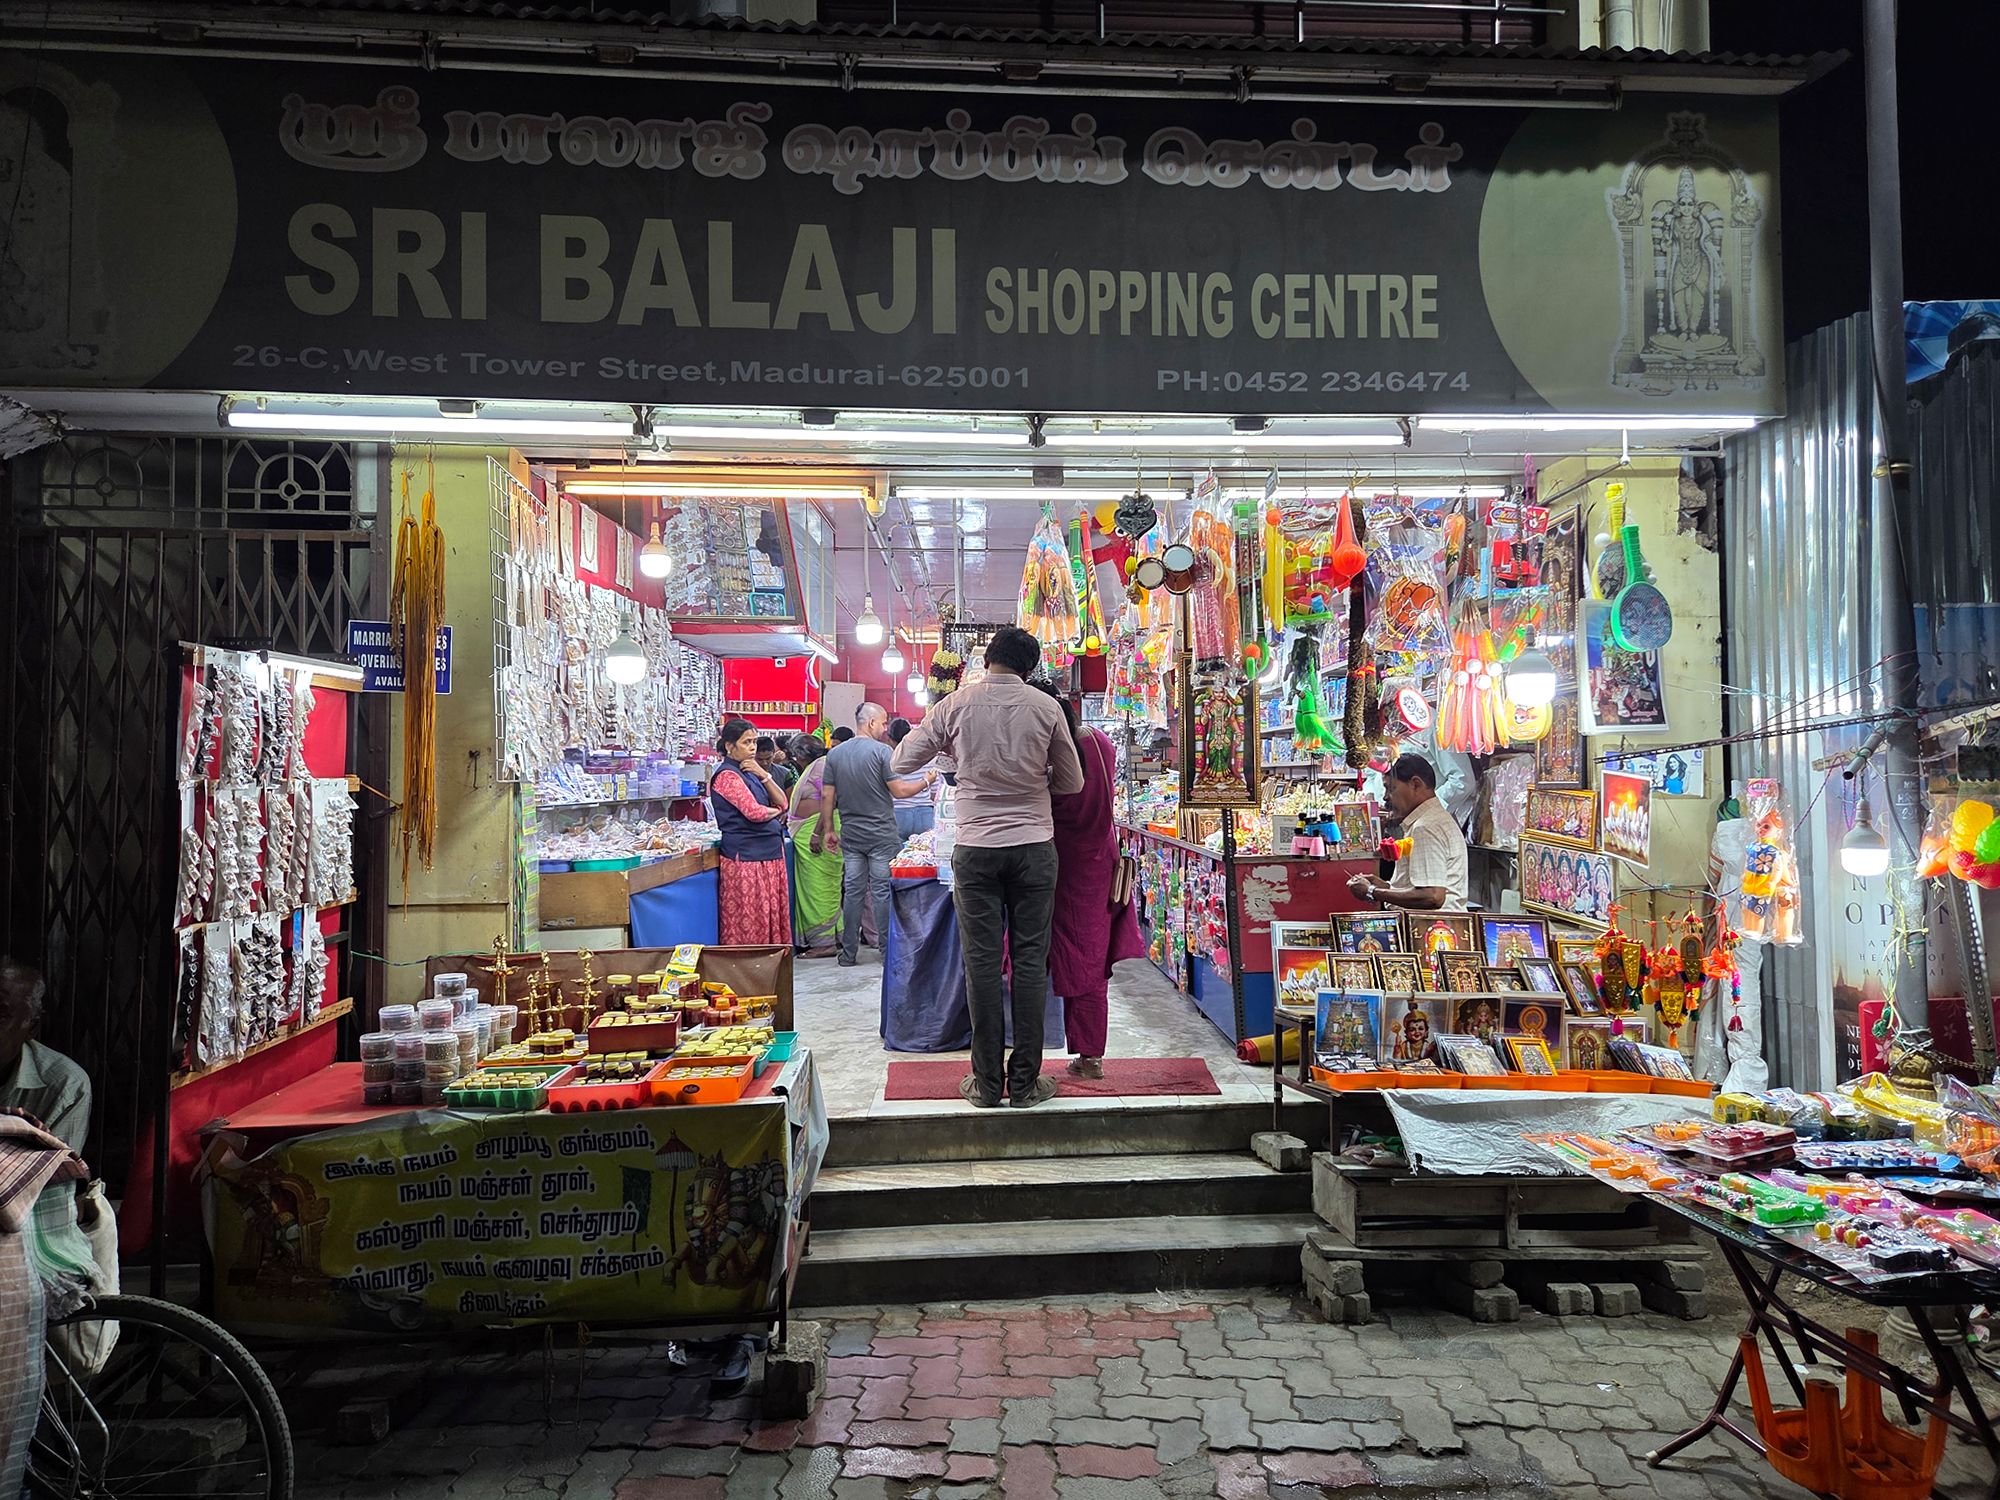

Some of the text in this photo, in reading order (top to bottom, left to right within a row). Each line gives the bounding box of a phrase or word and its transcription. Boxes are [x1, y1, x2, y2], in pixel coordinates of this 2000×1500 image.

[443, 101, 773, 180] பாலாஜி
[782, 107, 1129, 195] ஷாப்பிங்
[284, 202, 1440, 340] SRI BALAJI SHOPPING CENTRE
[231, 343, 1031, 389] 26-C,West Tower Street,Madurai-625001
[1156, 368, 1471, 393] PH:0452 2346474
[353, 630, 392, 647] MARRIA
[323, 1156, 397, 1181] இங்கு
[403, 1144, 458, 1175] நயம்
[559, 1123, 657, 1156] குங்குமம்,
[400, 1164, 596, 1204] நயம் மஞ்சள் தூள்,
[355, 1203, 639, 1252] கஸ்தூரி மஞ்சள், செந்தூரம்
